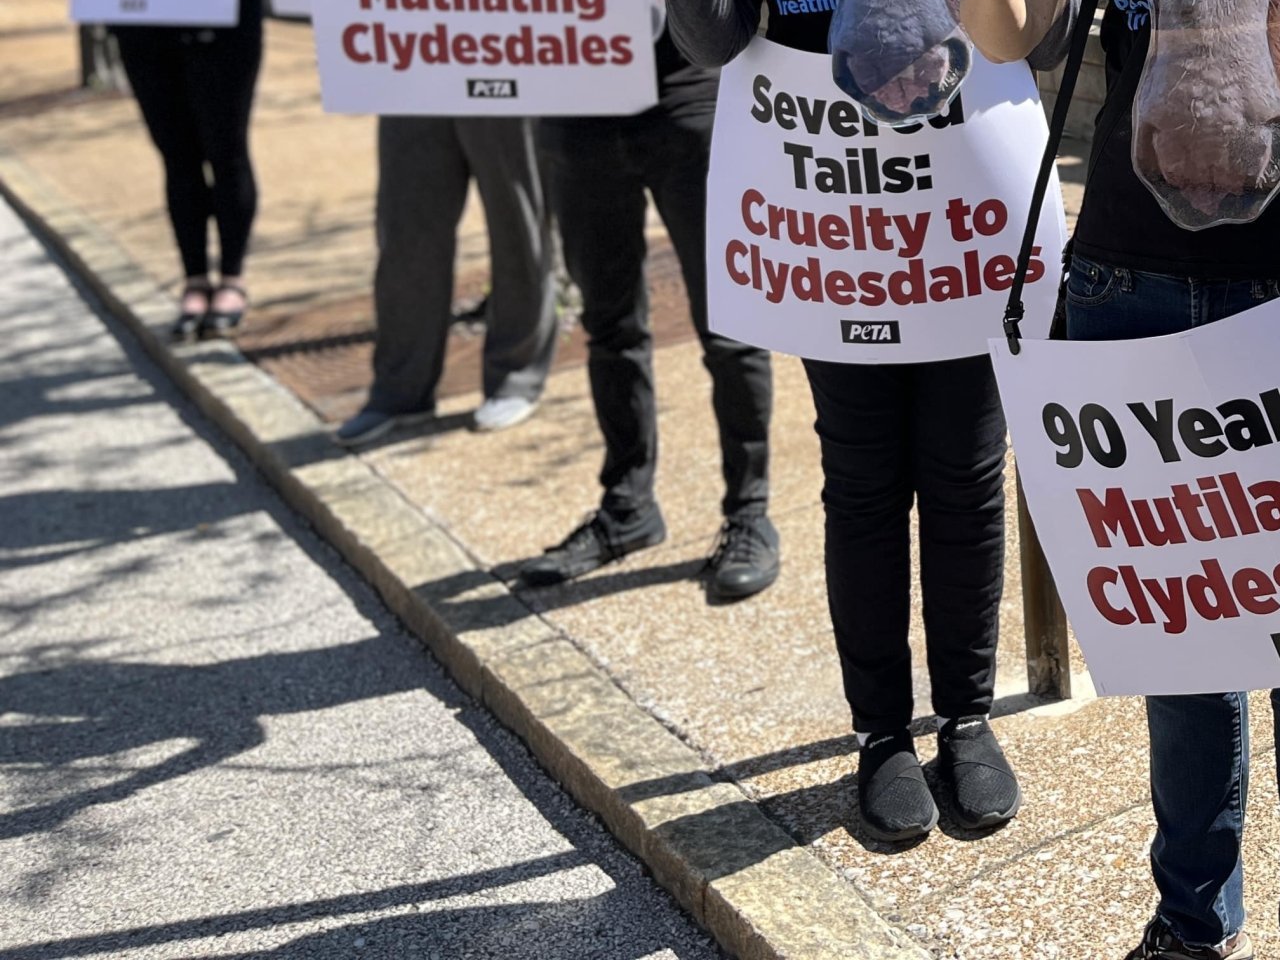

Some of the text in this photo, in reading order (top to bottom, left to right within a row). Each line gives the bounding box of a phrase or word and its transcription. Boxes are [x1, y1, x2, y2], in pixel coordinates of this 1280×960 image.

[342, 22, 634, 71] Clydesdales
[751, 74, 965, 137] Seve
[784, 142, 933, 194] Tails:
[741, 189, 1008, 258] Cruelty to
[725, 239, 1046, 307] Clydesdales
[1042, 401, 1127, 469] 90
